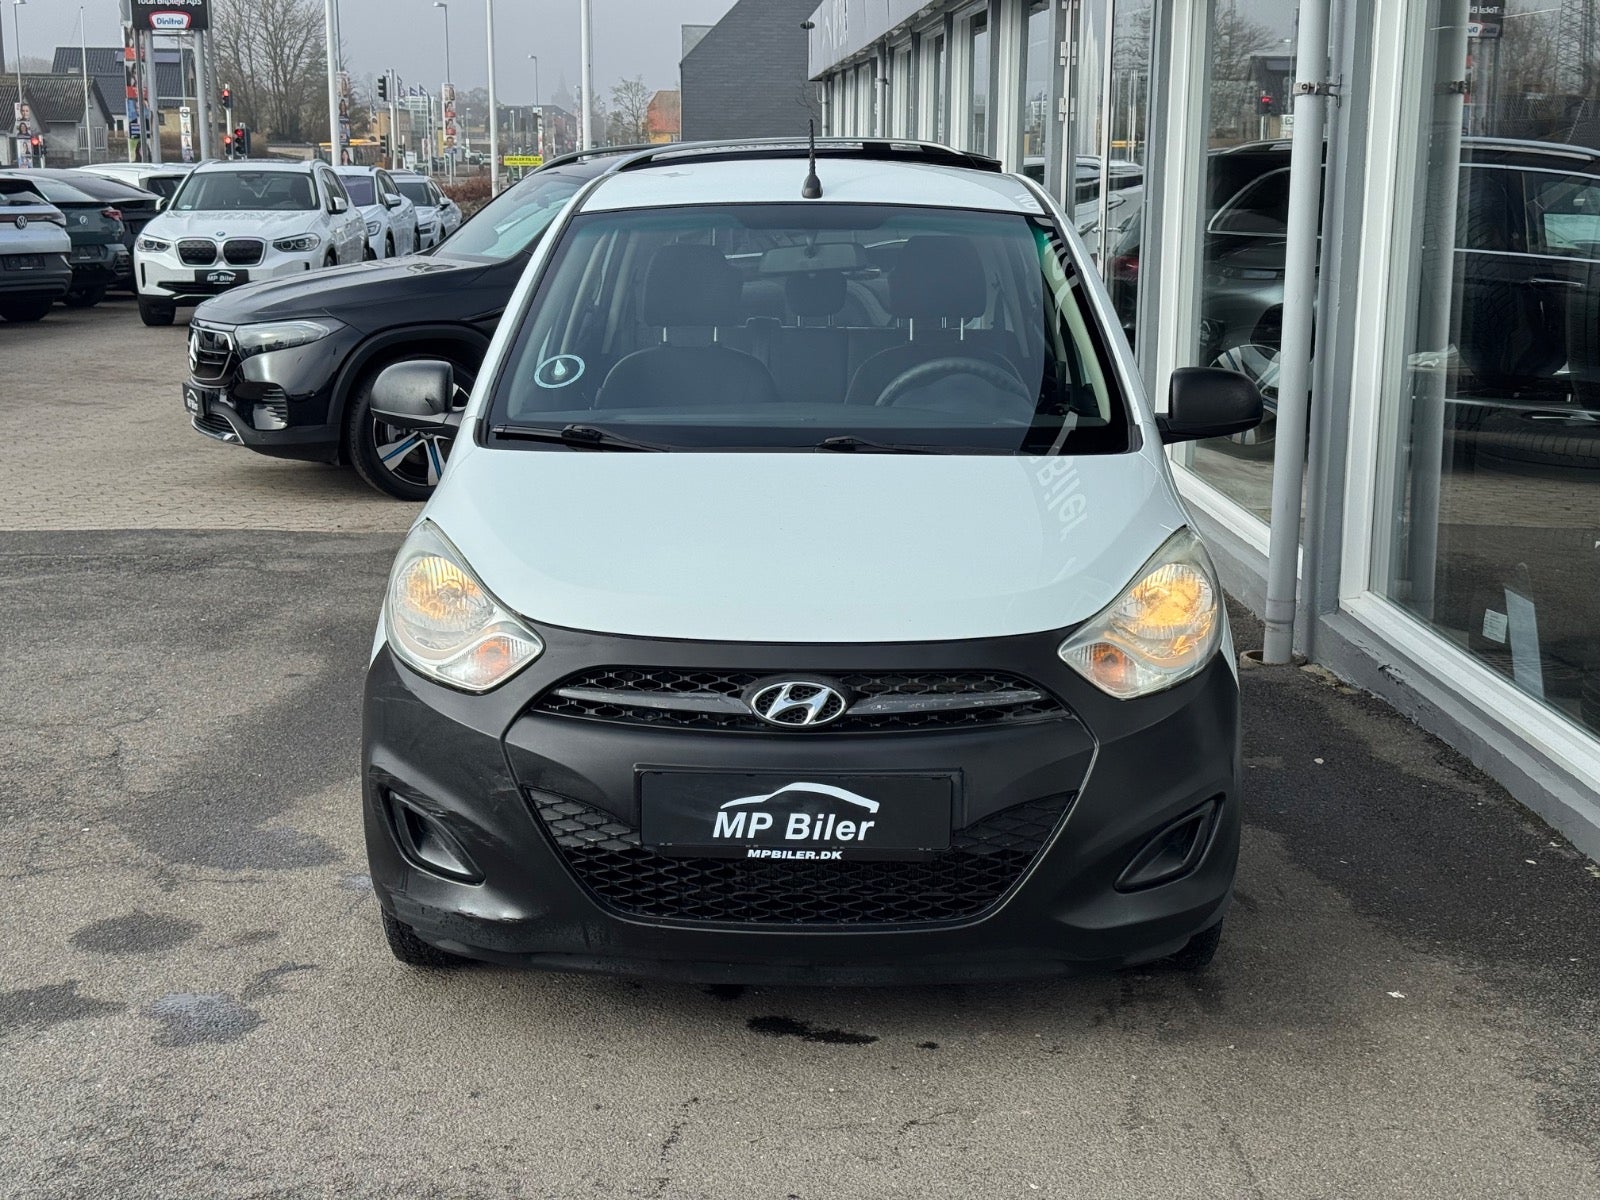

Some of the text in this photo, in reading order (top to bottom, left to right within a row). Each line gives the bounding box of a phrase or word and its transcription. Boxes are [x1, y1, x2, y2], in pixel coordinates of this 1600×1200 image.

[156, 17, 184, 25] Dinitrol
[713, 811, 875, 841] MP Biler
[747, 849, 843, 860] MPBILER.DK
